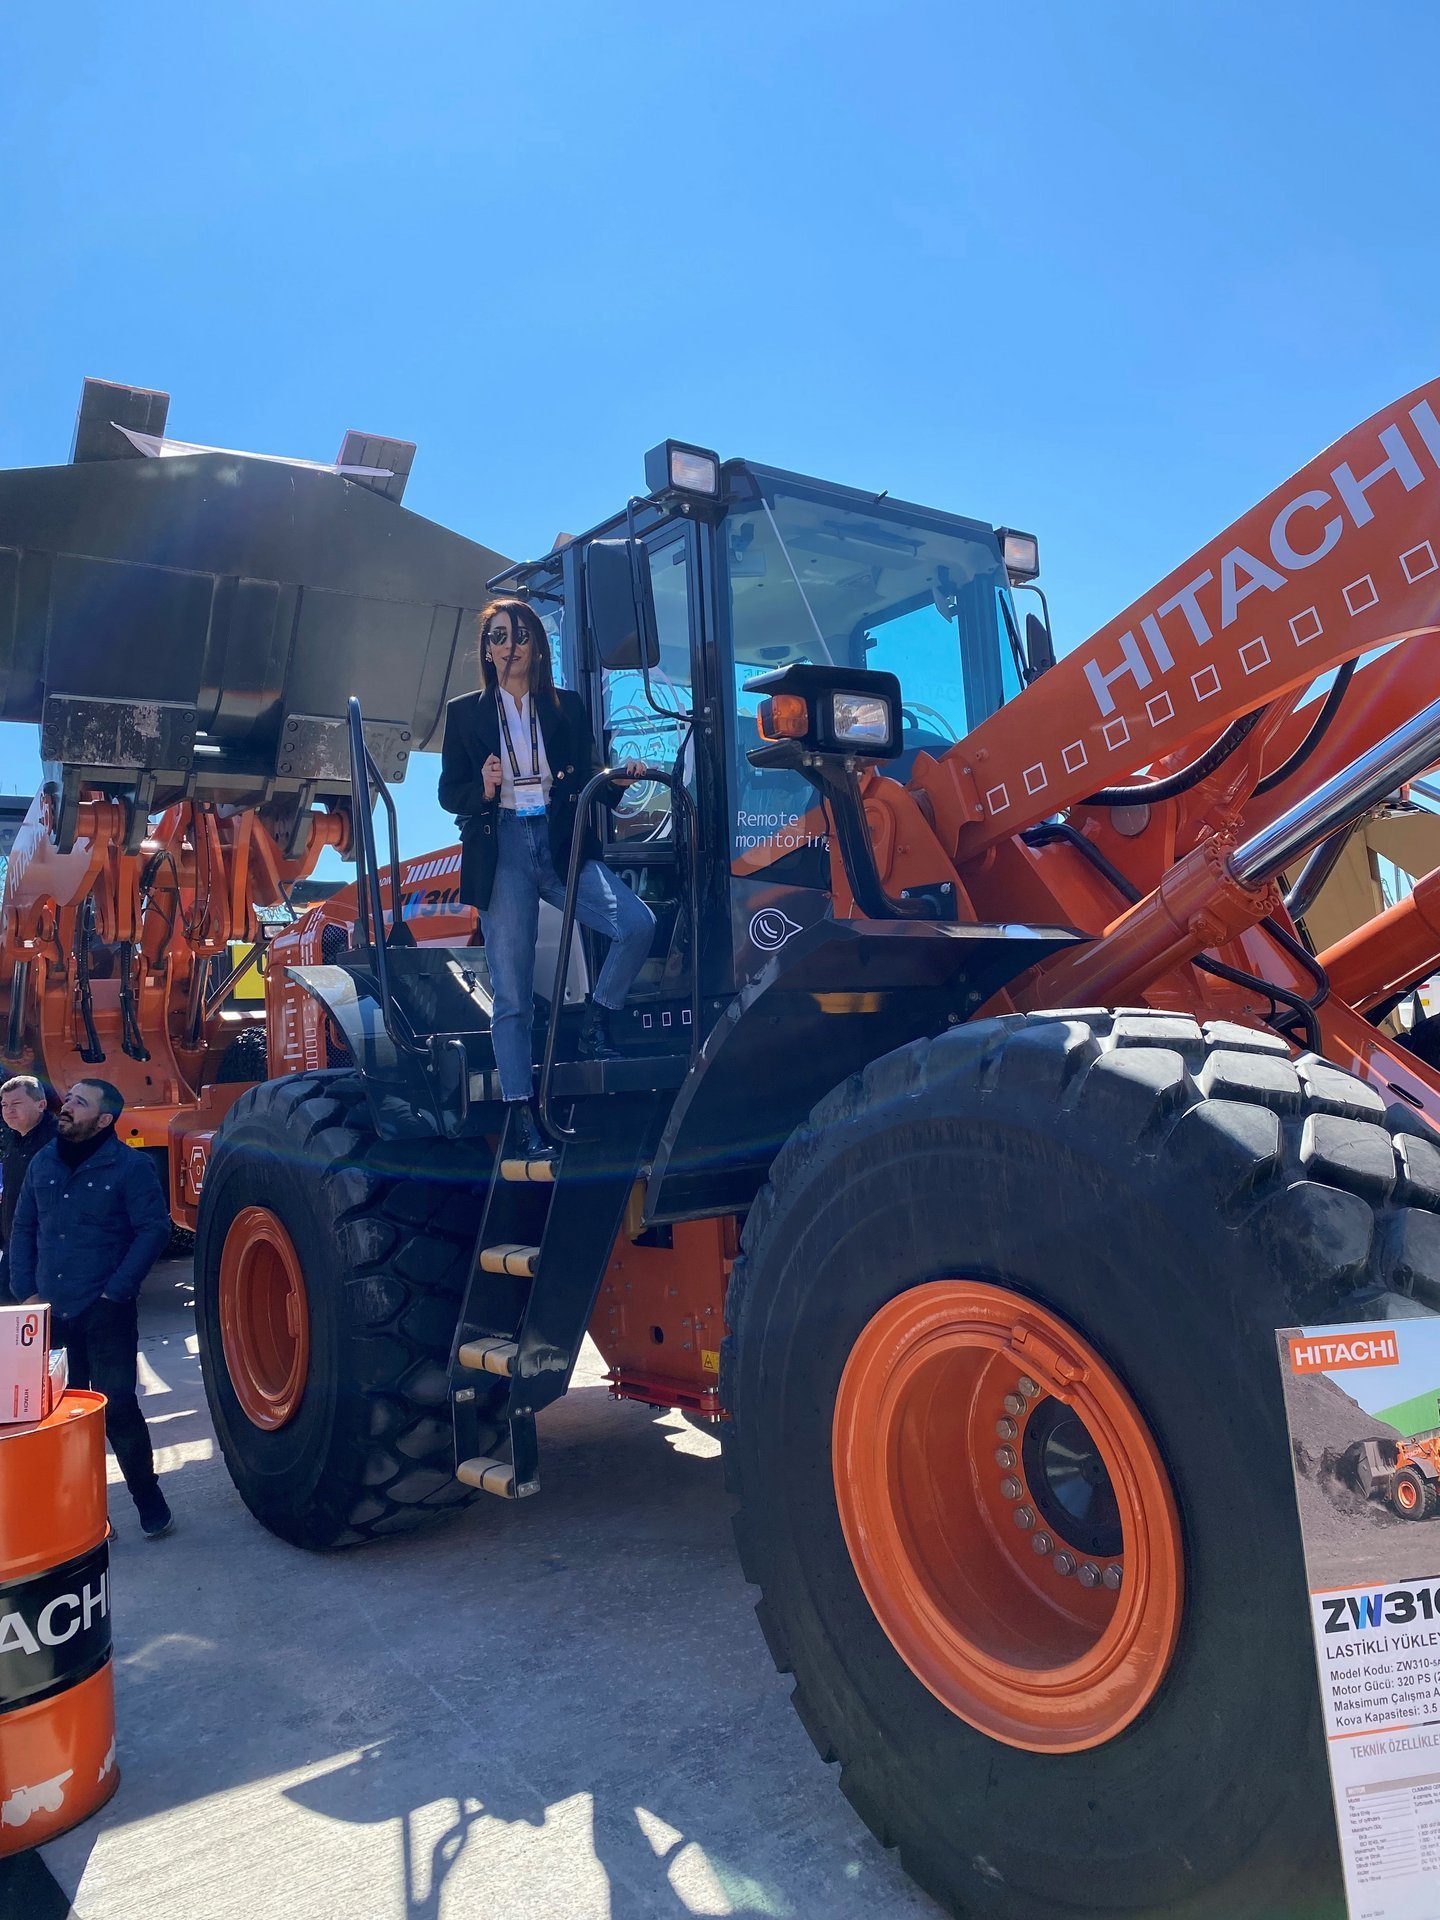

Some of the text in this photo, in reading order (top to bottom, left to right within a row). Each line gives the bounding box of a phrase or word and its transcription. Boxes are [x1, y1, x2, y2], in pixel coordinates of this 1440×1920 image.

[1083, 399, 1440, 717] HITACHI
[737, 811, 799, 827] Remote
[1294, 1339, 1395, 1366] HITACHI
[1322, 1588, 1440, 1634] ZW31
[1326, 1636, 1389, 1660] LASTİKLİ
[1330, 1667, 1361, 1681] Model
[1363, 1664, 1394, 1677] Kodu:
[1332, 1684, 1361, 1697] Motor
[1364, 1679, 1395, 1692] Gücü:
[1397, 1675, 1415, 1687] 320
[1417, 1673, 1431, 1684] PS
[1334, 1696, 1389, 1712] Maksimum
[1391, 1690, 1431, 1705] Çalışma
[1336, 1716, 1362, 1728] Kova
[1365, 1705, 1421, 1724] Kapasitesi:
[1350, 1734, 1440, 1759] TEKNİK ÖZELLİKLE
